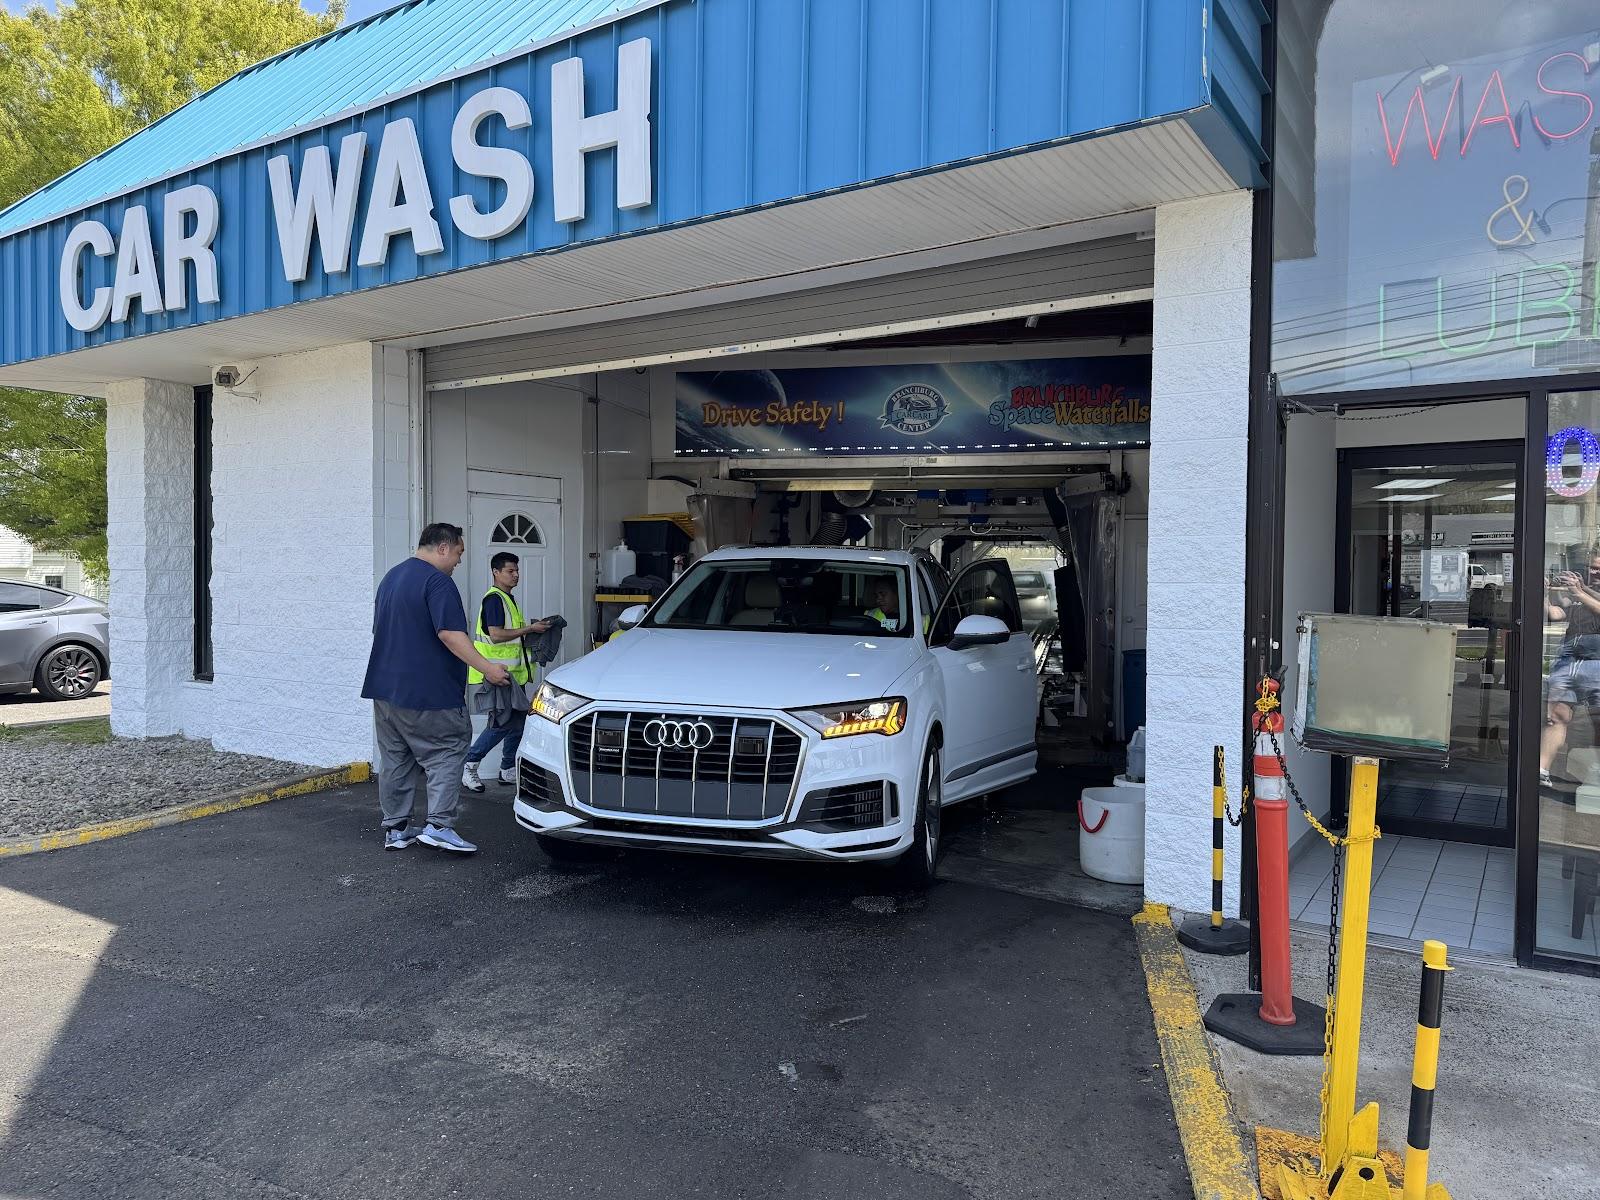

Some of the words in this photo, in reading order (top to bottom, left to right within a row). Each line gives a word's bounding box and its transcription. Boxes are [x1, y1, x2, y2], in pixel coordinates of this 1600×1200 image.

[60, 184, 219, 332] CAR
[268, 37, 652, 282] WASH
[1486, 175, 1537, 249] &
[1378, 262, 1600, 360] LUB
[703, 402, 762, 427] Drive
[892, 387, 939, 402] BRANCHBURG
[897, 422, 932, 432] CENTER
